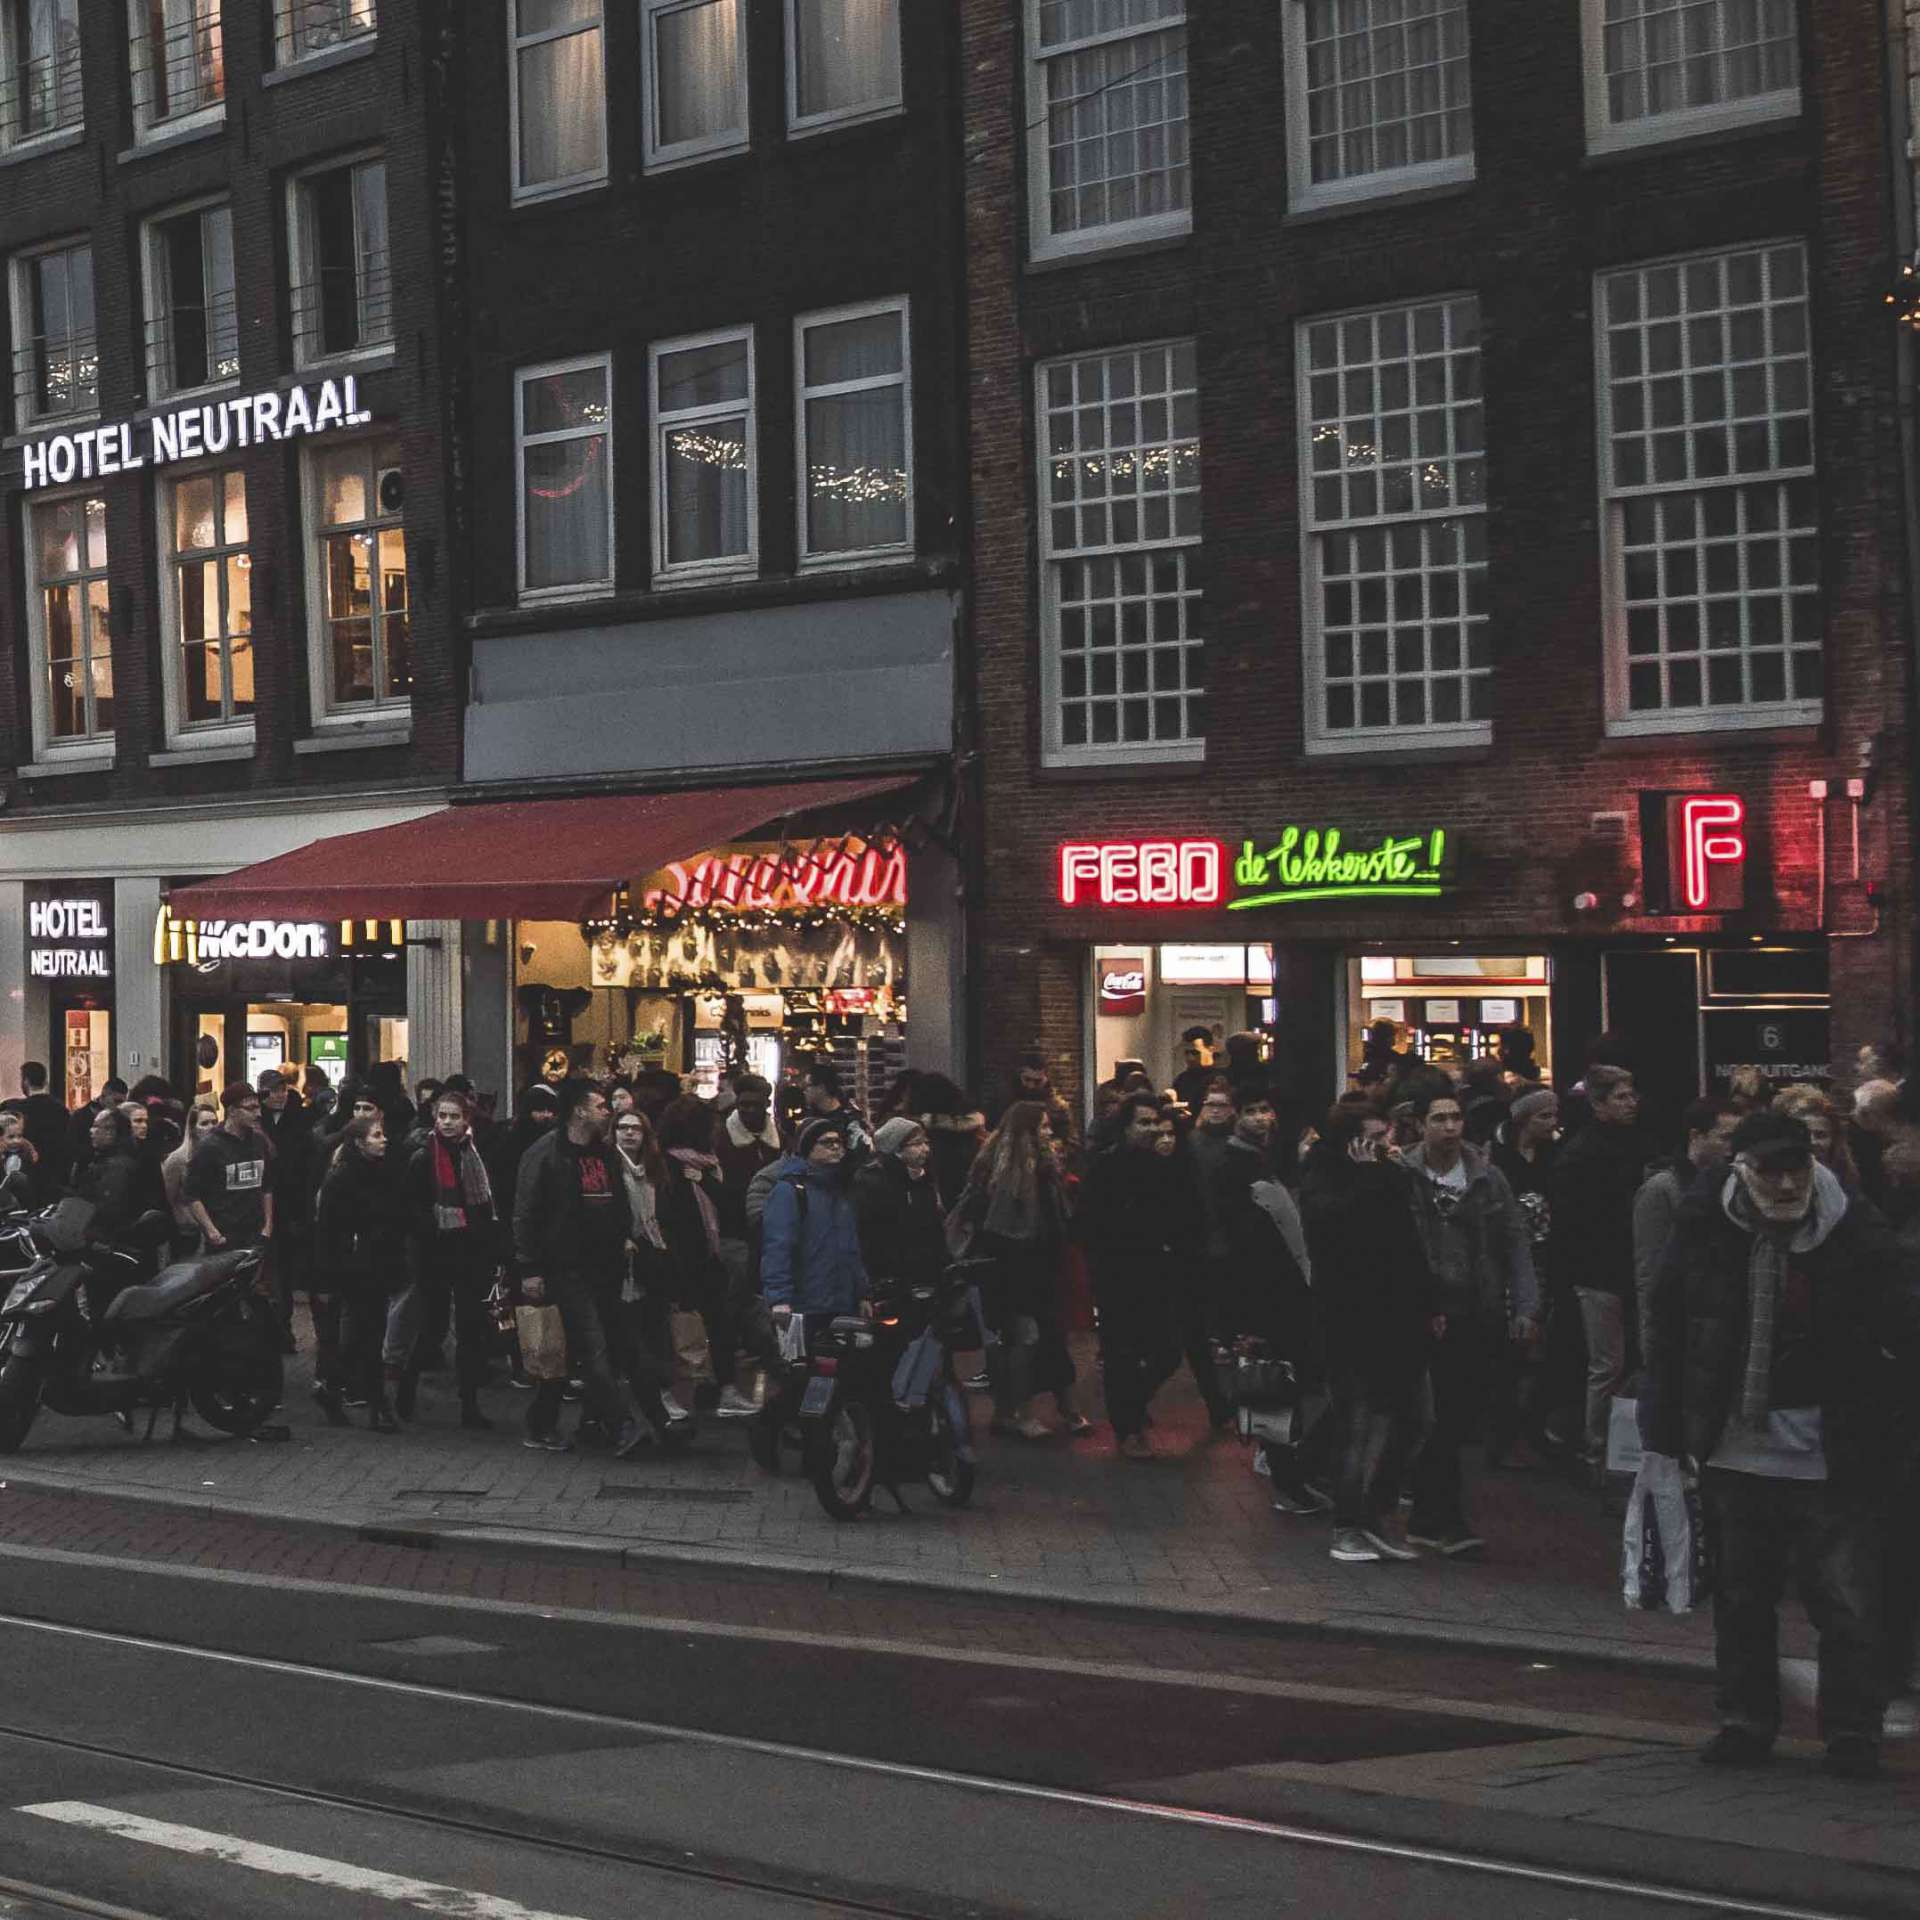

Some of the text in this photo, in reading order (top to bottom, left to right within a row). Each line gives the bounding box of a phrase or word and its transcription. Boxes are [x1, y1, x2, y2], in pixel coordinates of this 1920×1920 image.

[23, 375, 371, 490] HOTEL NEUTRAAL
[1236, 840, 1269, 886] de
[1683, 798, 1743, 907] F
[30, 901, 107, 937] HOTEL
[198, 920, 328, 958] McDon
[30, 950, 109, 976] NEUTRAAL
[1762, 1025, 1780, 1048] 6
